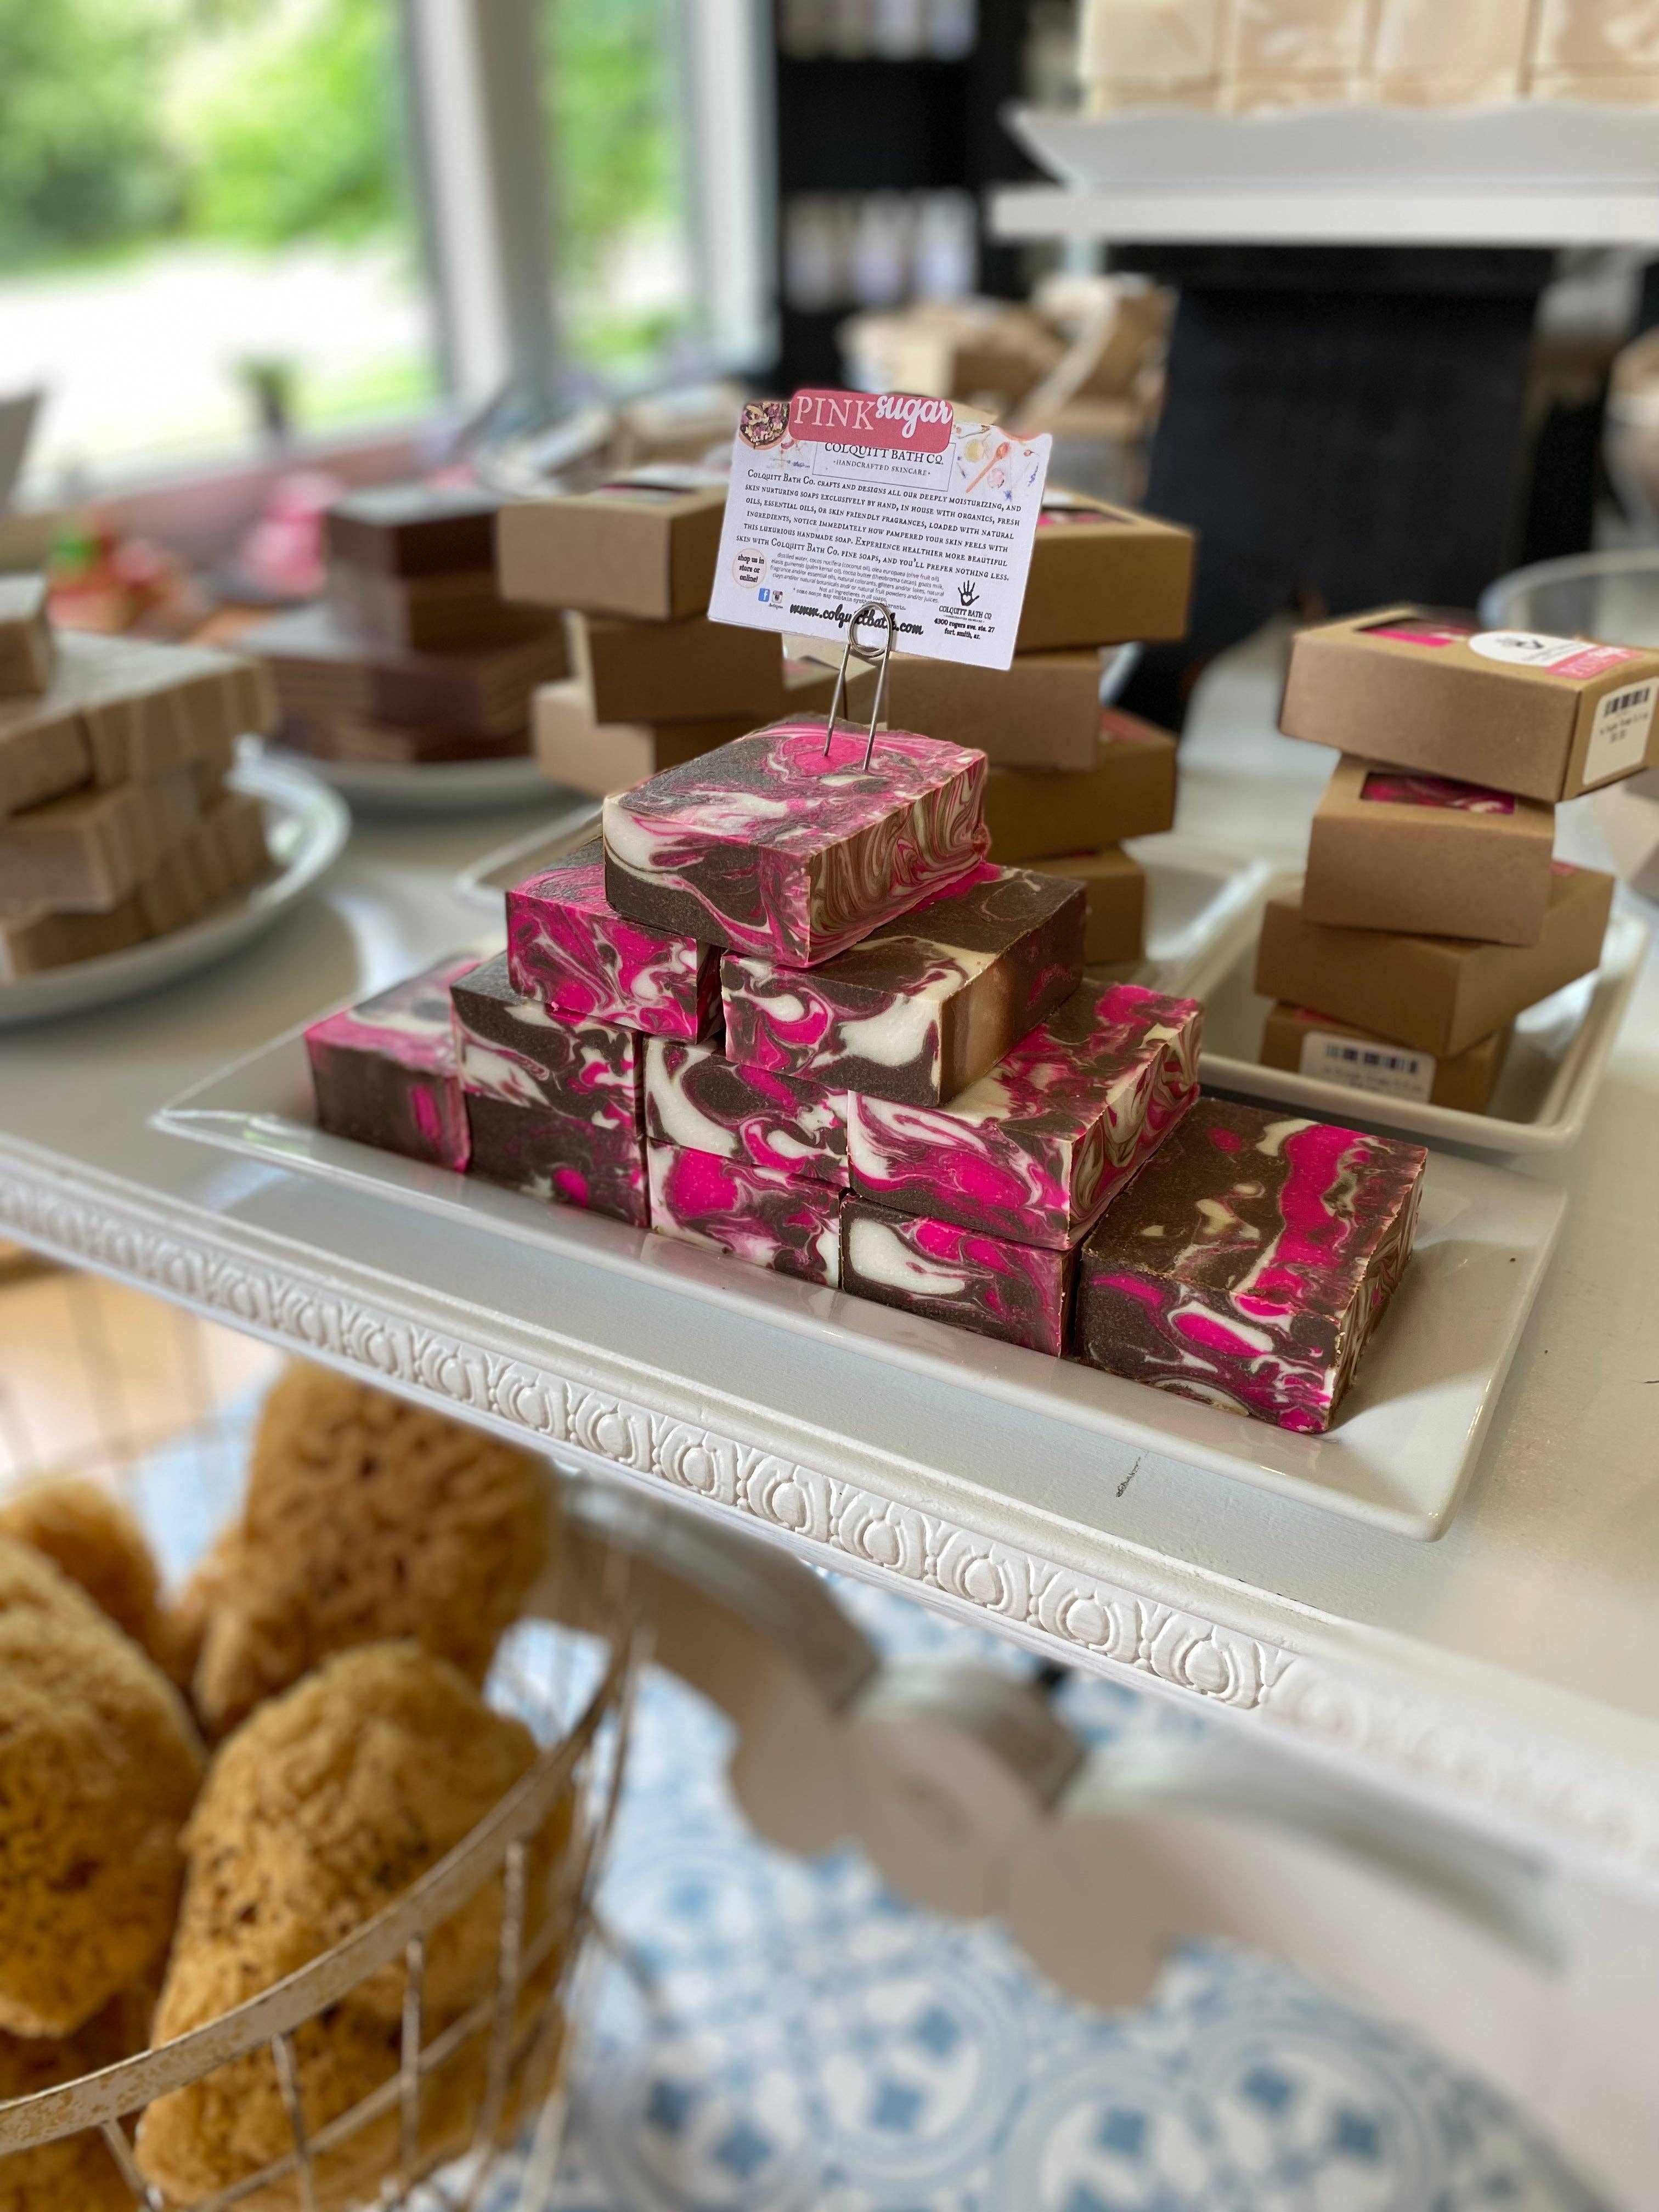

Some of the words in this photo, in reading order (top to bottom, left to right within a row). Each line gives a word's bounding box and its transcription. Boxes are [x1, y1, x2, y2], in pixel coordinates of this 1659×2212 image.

[794, 396, 876, 430] PINK
[875, 395, 953, 438] sugar
[825, 442, 889, 458] COLQUITT
[891, 449, 924, 463] BATH
[761, 486, 798, 496] NURTURING
[800, 491, 819, 499] SOAPS
[821, 494, 865, 505] EXCLUSIVELY
[911, 506, 934, 515] HOUSE
[936, 509, 955, 518] WITH
[997, 517, 1019, 526] FRESH
[817, 480, 840, 488] CRAFTS
[858, 485, 886, 495] DESIGNS
[919, 493, 947, 502] DEEPLY
[764, 500, 797, 510] ESSENTIAL
[846, 511, 879, 521] FRIENDLY
[929, 522, 958, 532] LOADED
[960, 526, 979, 535] WITH
[981, 529, 1014, 539] NATURAL
[794, 517, 817, 526] NOTICE
[819, 520, 866, 533] IMMEDIATELY
[886, 530, 923, 540] PAMPERED
[926, 535, 943, 544] YOUR
[964, 541, 986, 550] FEELS
[989, 544, 1008, 552] WITH
[738, 554, 750, 564] shop
[753, 537, 769, 546] WITH
[842, 550, 857, 558] FINE
[900, 558, 924, 568] YOU'LL
[927, 563, 952, 573] PREFER
[956, 567, 988, 578] NOTHING
[759, 525, 795, 536] LUXURIOUS
[797, 531, 833, 541] HANDMADE
[902, 546, 943, 558] HEALTHIER
[945, 552, 965, 561] MORE
[968, 555, 1008, 567] BEAUTIFUL
[939, 606, 967, 616] COLQUITT
